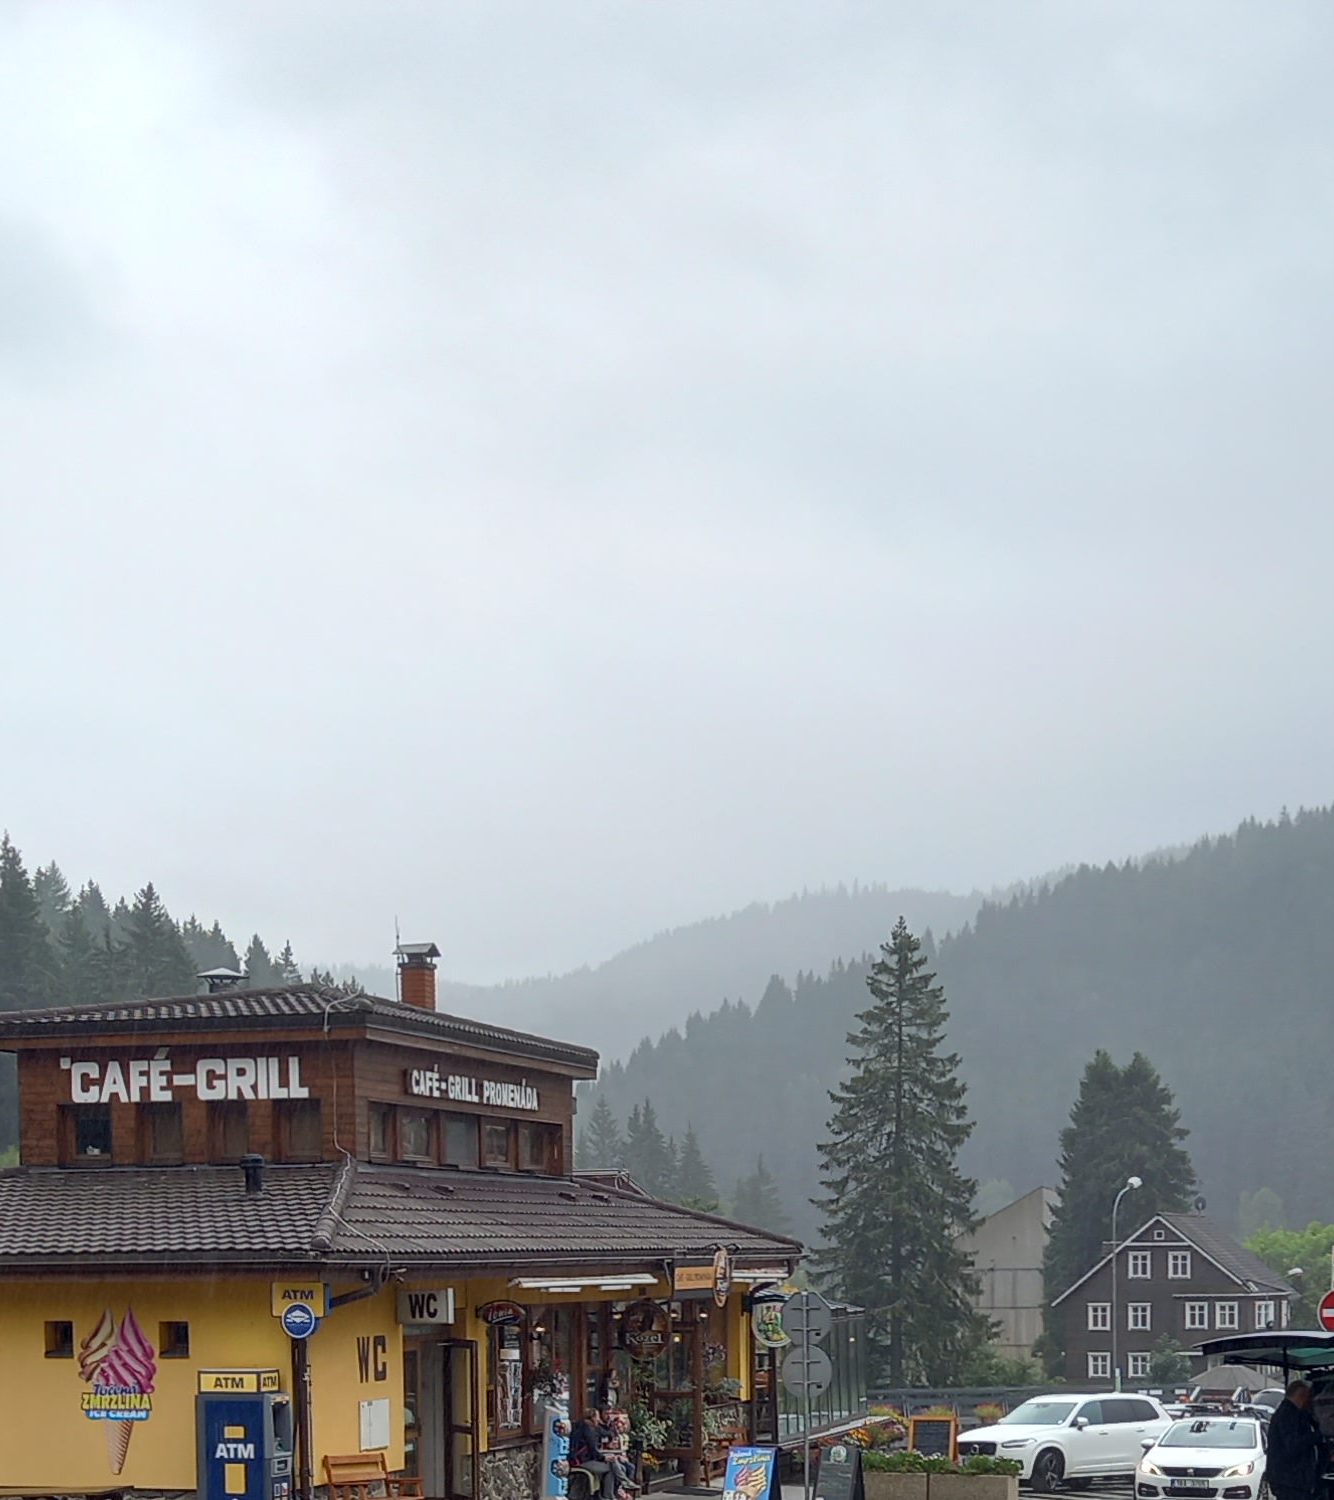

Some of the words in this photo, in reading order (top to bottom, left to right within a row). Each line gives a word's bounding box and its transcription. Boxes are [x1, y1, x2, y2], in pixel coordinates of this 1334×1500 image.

[482, 1078, 540, 1111] PROMENÁDA
[281, 1289, 314, 1301] ATM
[408, 1293, 438, 1319] WC
[625, 1332, 665, 1345] Kozel
[356, 1334, 387, 1384] WC
[213, 1377, 245, 1390] ATM
[262, 1375, 277, 1388] ATM
[81, 1393, 152, 1410] ZMRZLINA
[89, 1410, 107, 1418] ICE
[108, 1410, 147, 1419] CREAM
[215, 1443, 255, 1459] ATM
